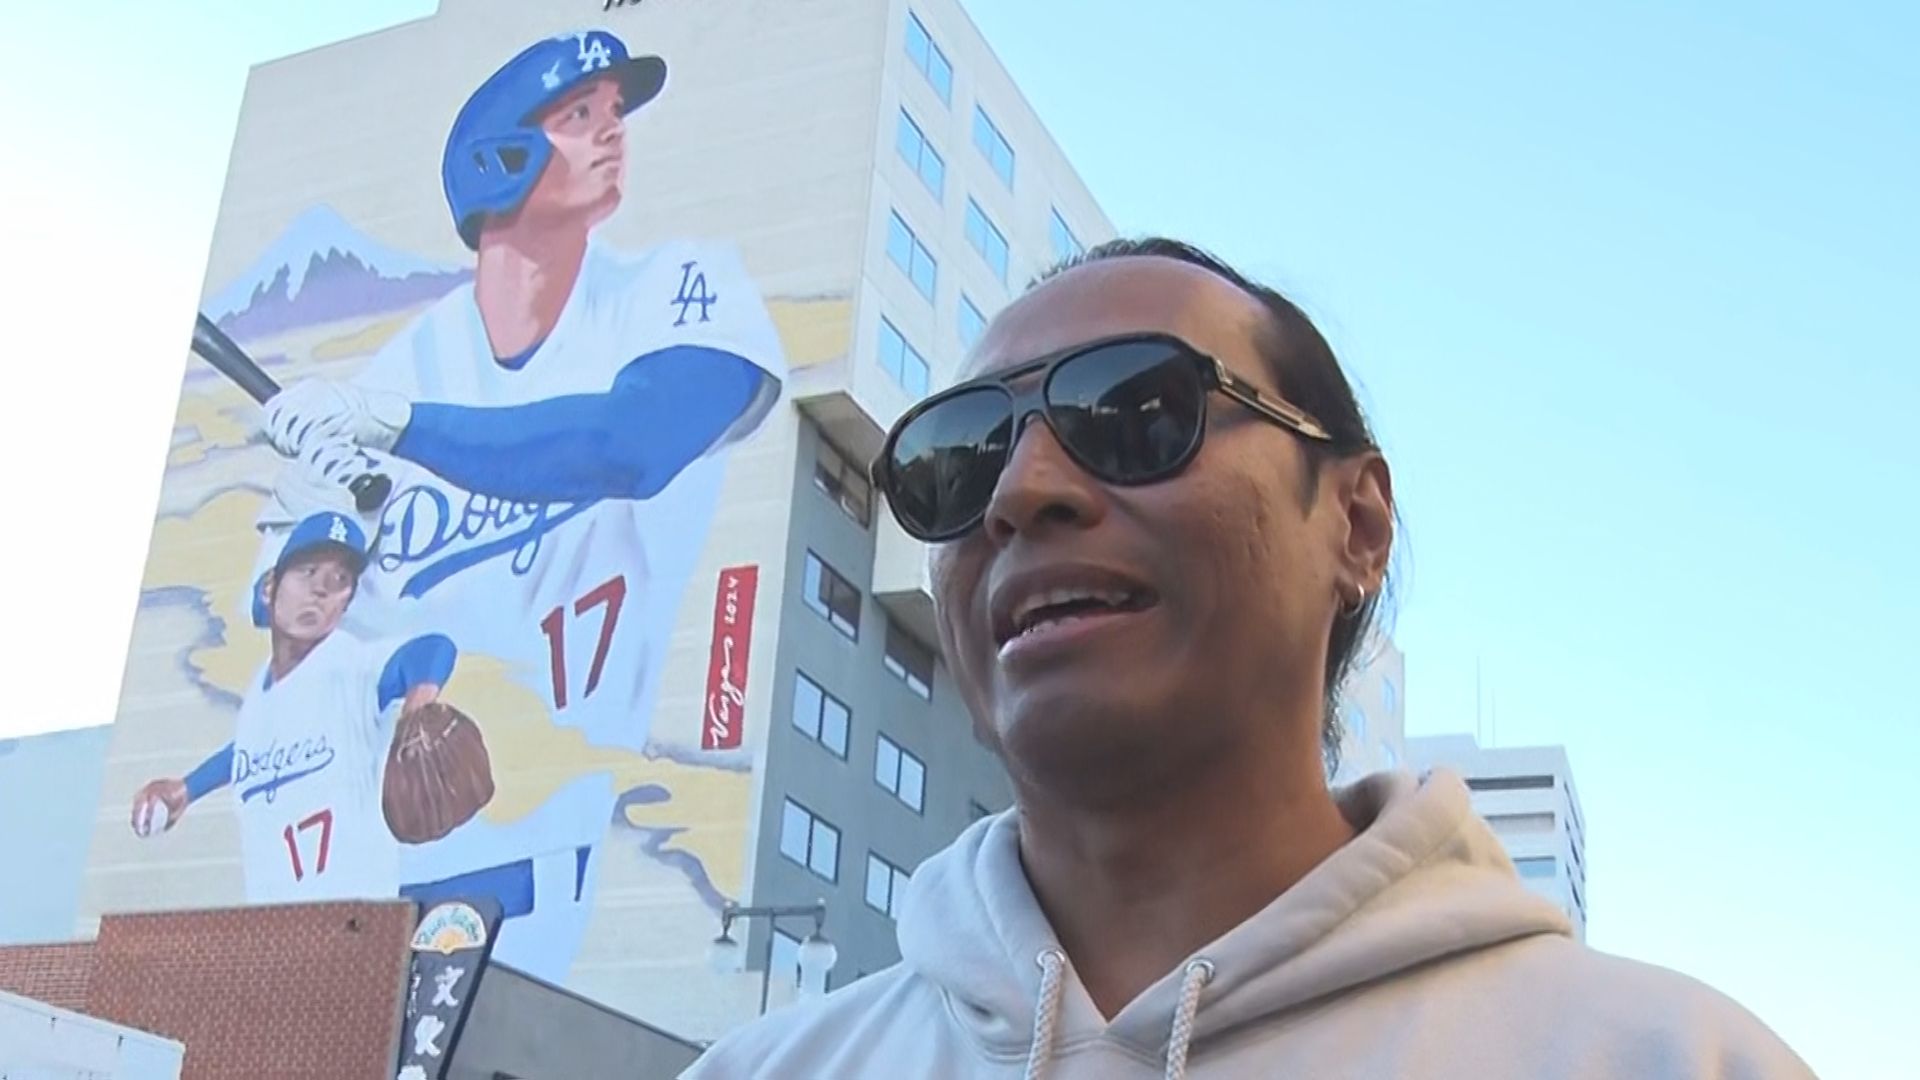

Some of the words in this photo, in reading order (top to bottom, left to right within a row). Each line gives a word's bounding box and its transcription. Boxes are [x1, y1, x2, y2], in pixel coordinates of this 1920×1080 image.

[573, 31, 611, 72] LA
[670, 260, 717, 327] LA
[540, 574, 627, 711] 17
[234, 735, 334, 804] Dodgers
[284, 808, 332, 882] 17
